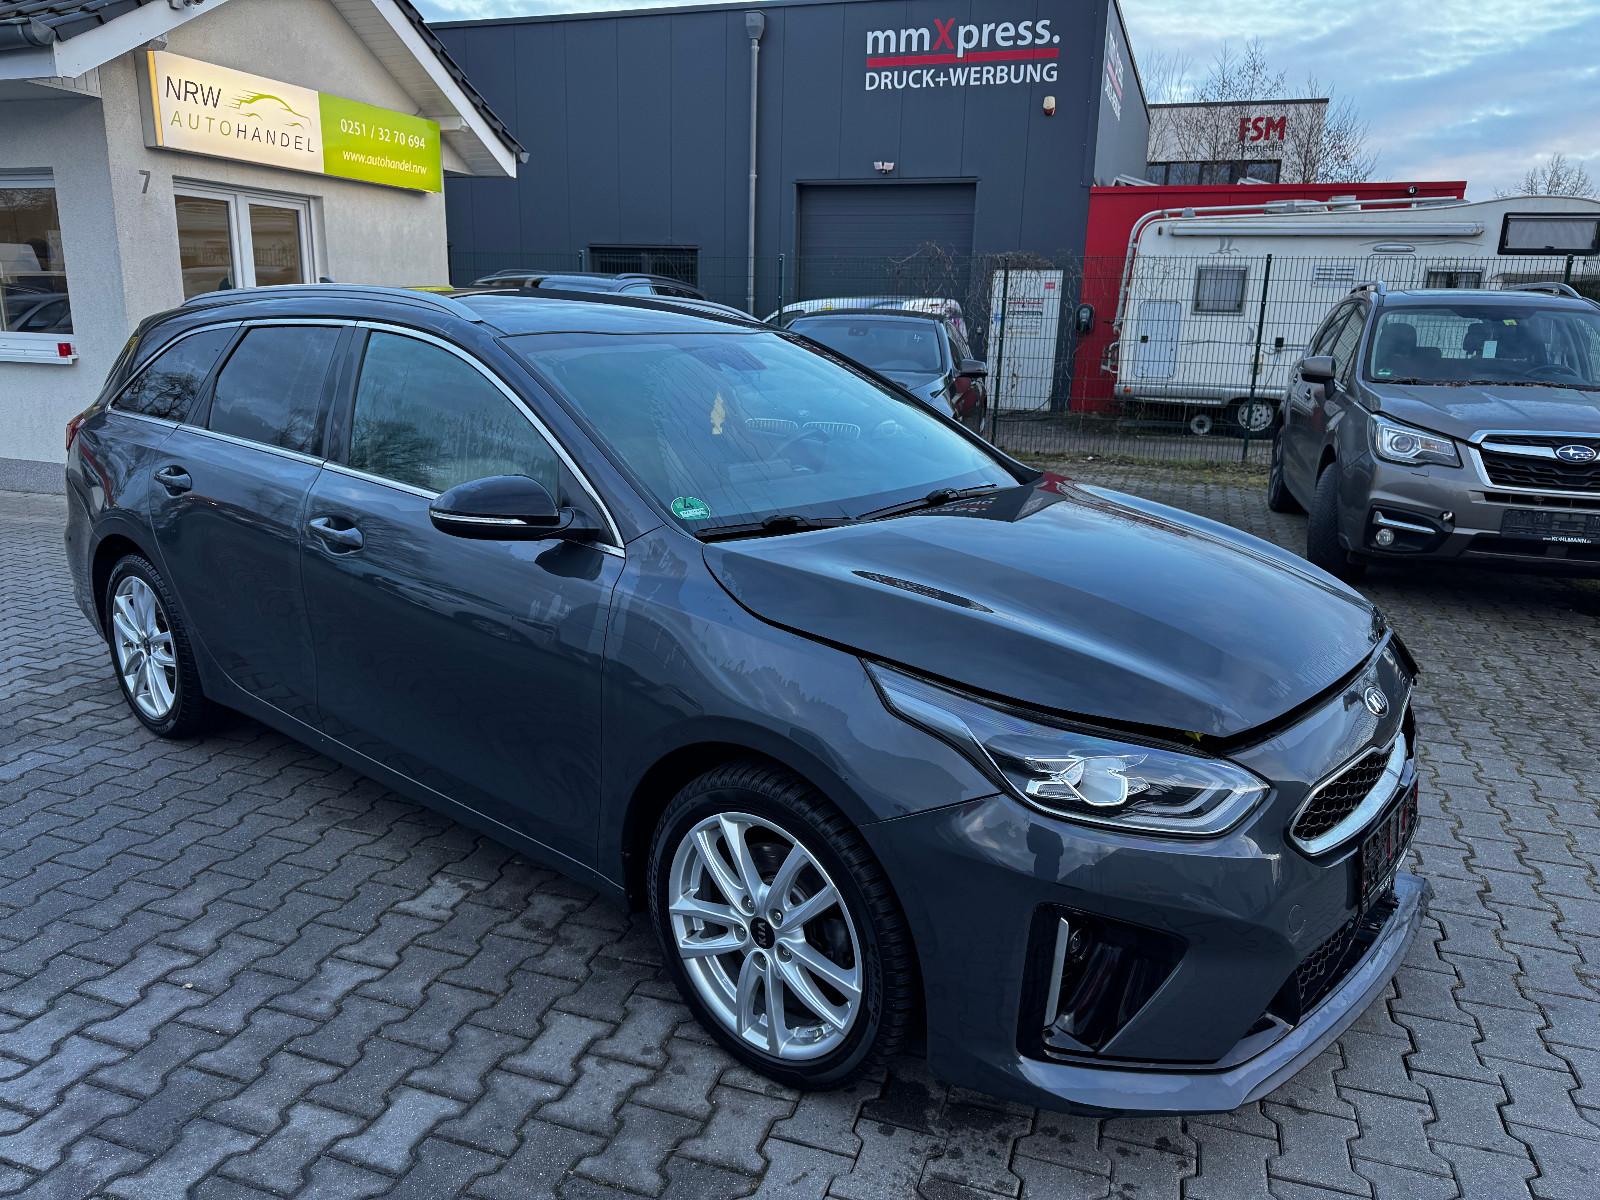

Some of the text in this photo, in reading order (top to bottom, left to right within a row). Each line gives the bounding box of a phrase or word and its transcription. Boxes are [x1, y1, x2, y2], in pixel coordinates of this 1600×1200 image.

[866, 18, 1061, 58] mmXpress.
[865, 62, 1059, 91] DRUCK+WERBUNG
[165, 76, 222, 109] NRW
[170, 110, 315, 153] AUTOHANDEL
[340, 118, 426, 149] 0251 / 32 70 694
[1238, 115, 1287, 143] FSM
[342, 150, 428, 175] www.autohandel.nrw
[138, 169, 151, 194] 7
